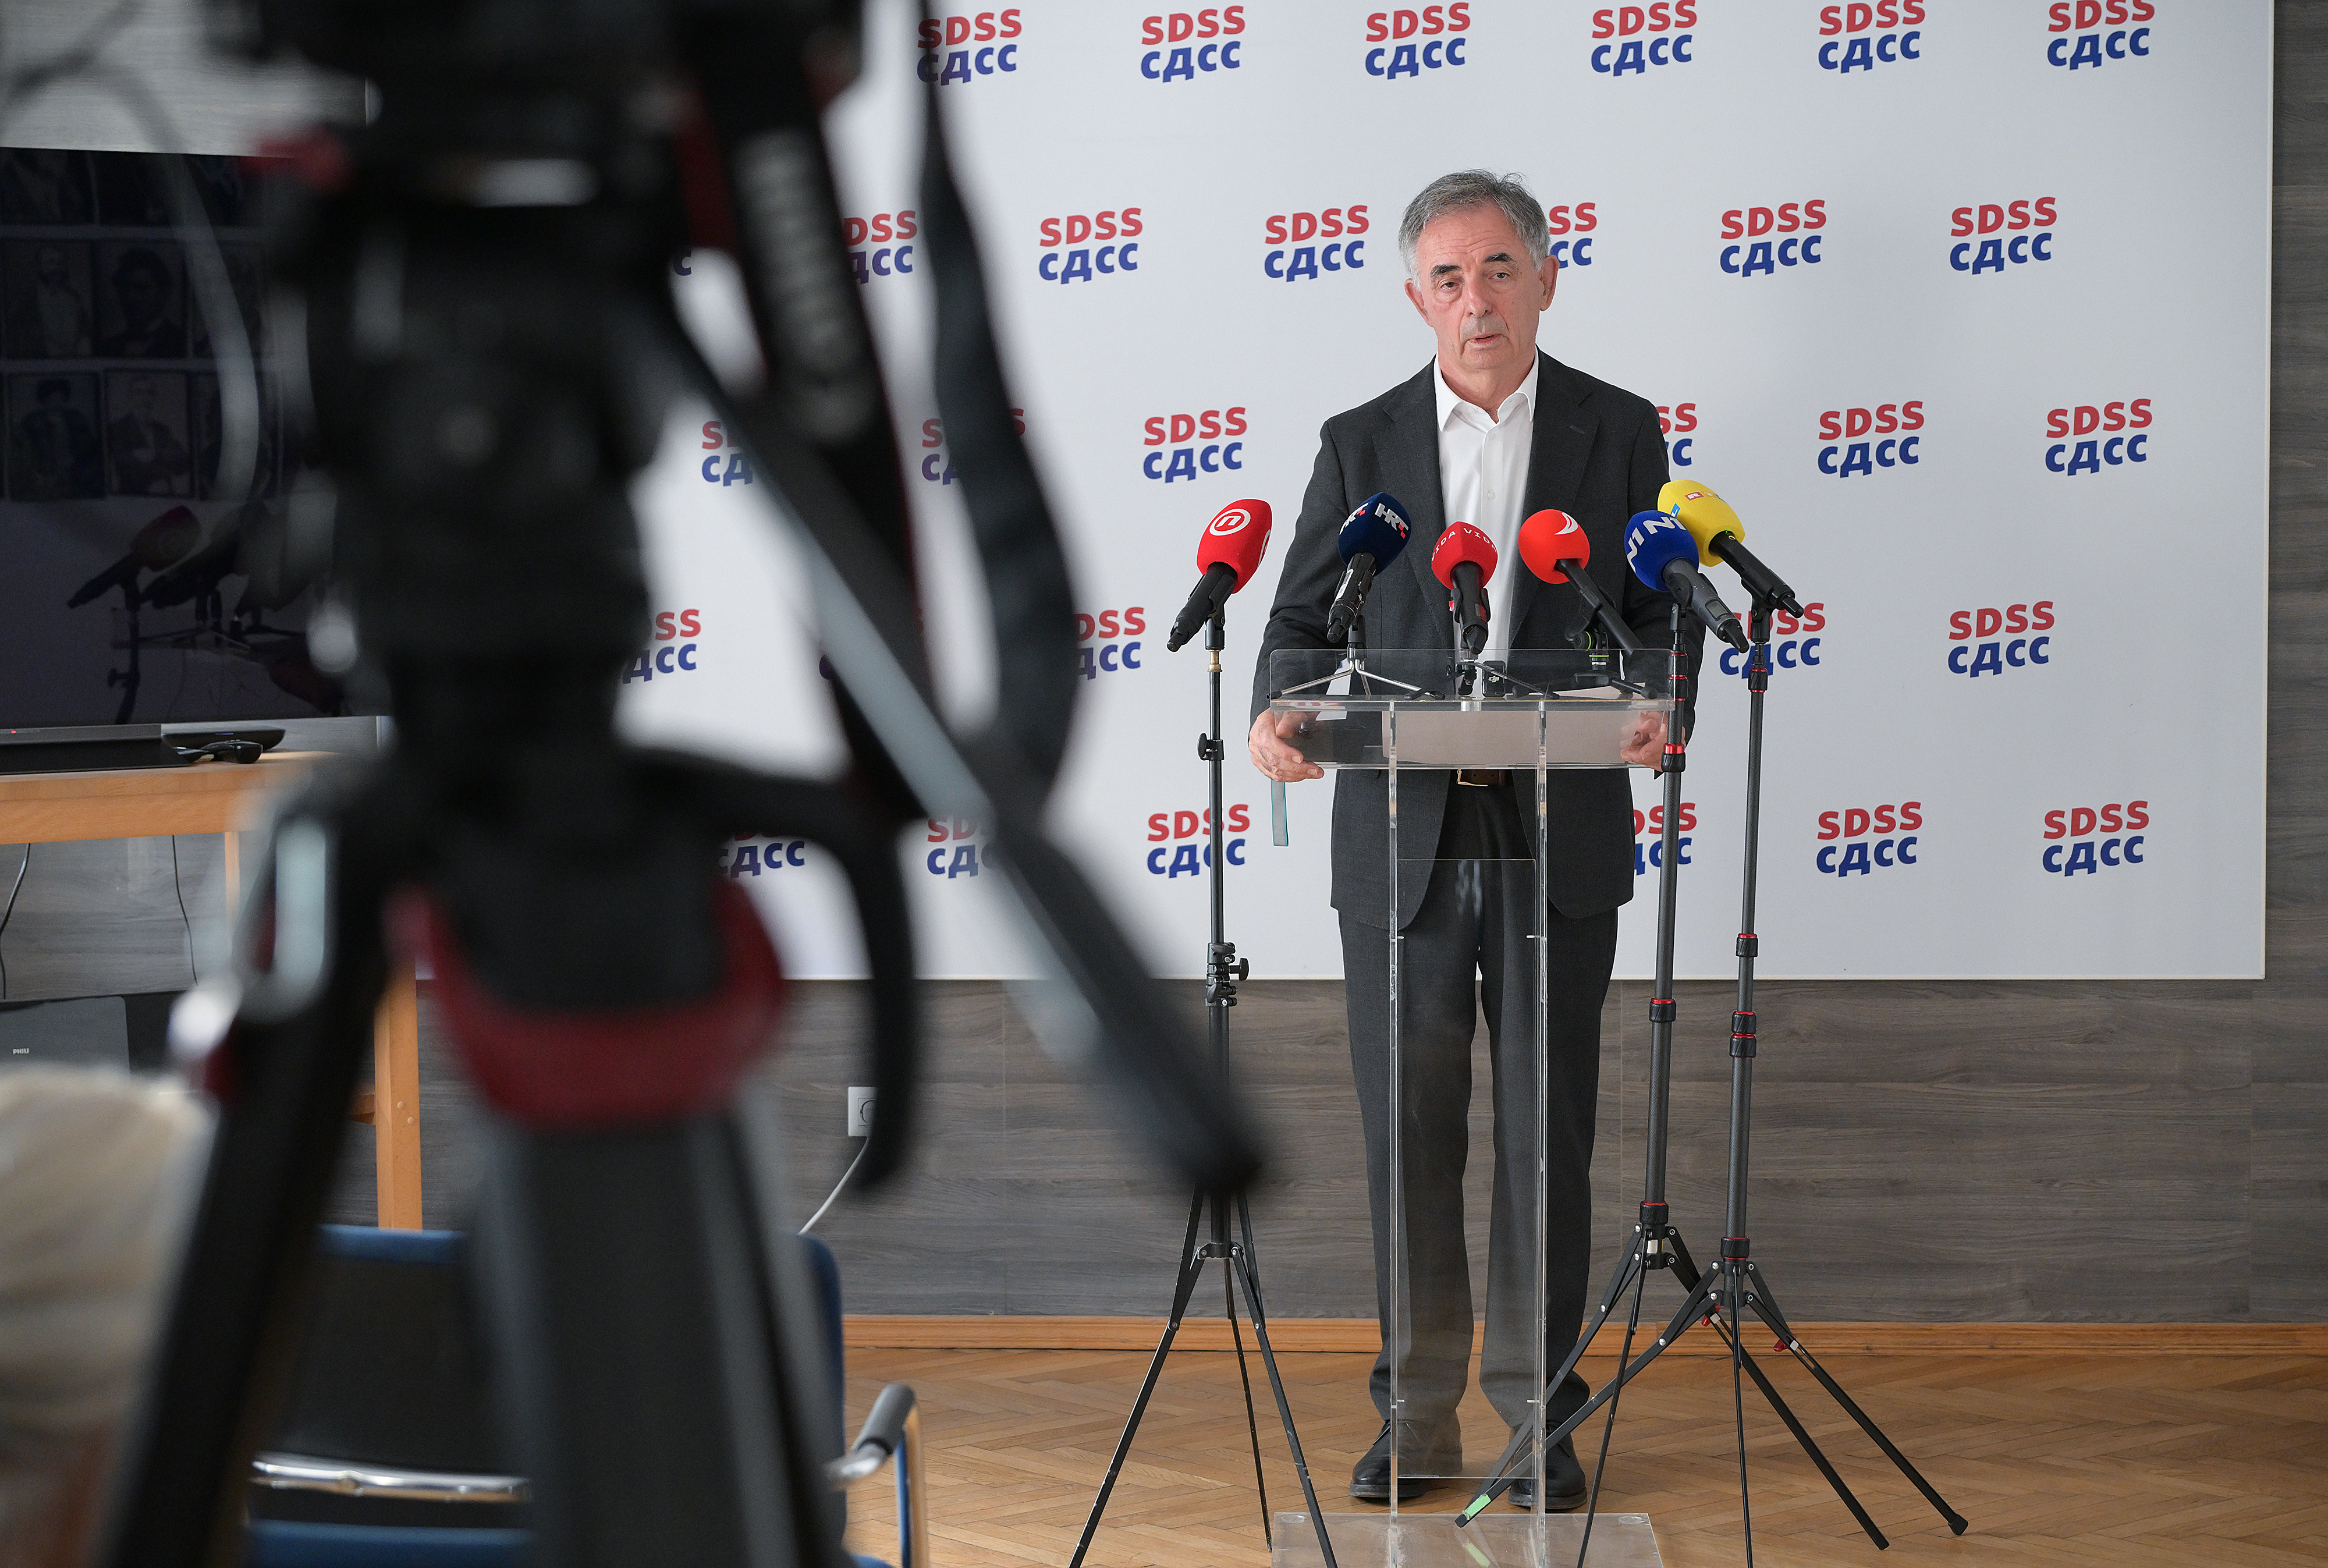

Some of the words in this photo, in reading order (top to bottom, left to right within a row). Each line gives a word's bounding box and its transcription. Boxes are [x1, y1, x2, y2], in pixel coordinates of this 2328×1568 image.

[918, 9, 1021, 49] SDSS
[1142, 5, 1245, 45] SDSS
[1366, 2, 1471, 42] SDSS
[1592, 0, 1697, 39] SDSS
[1819, 0, 1925, 36] SDSS
[2048, 0, 2155, 32] SDSS
[1141, 41, 1241, 83] СДСС
[1365, 37, 1466, 80] СДСС
[1591, 34, 1692, 77] СДСС
[1818, 31, 1921, 73] СДСС
[2047, 28, 2150, 70] СДСС
[844, 210, 917, 246] DSS
[1039, 208, 1143, 247] SDSS
[1265, 205, 1369, 244] SDSS
[1549, 202, 1597, 235] SS
[1721, 200, 1826, 239] SDSS
[1951, 197, 2057, 237] SDSS
[849, 246, 913, 284] ДСС
[1039, 243, 1138, 285] СДСС
[1265, 240, 1365, 282] СДСС
[1550, 237, 1592, 269] СС
[1720, 235, 1822, 278] СДСС
[1950, 232, 2052, 275] СДСС
[1144, 407, 1247, 446] SDSS
[1819, 400, 1925, 441] SDSS
[2046, 398, 2152, 438] SDSS
[702, 455, 753, 487] СД
[1143, 442, 1243, 484] СДСС
[1818, 437, 1919, 478] СДСС
[2046, 434, 2148, 476] СДСС
[1374, 503, 1409, 539] HRT
[655, 609, 701, 641] SS
[1073, 606, 1145, 642] DSS
[1949, 601, 2054, 640] SDSS
[622, 644, 697, 684] ДСС
[1078, 641, 1141, 680] ДСС
[1949, 636, 2049, 677] СДСС
[927, 815, 978, 843] SD
[1817, 801, 1922, 840] SDSS
[2043, 800, 2149, 839] SDSS
[927, 845, 989, 879] СД
[1816, 836, 1918, 877] СДСС
[2043, 836, 2144, 877] СДСС
